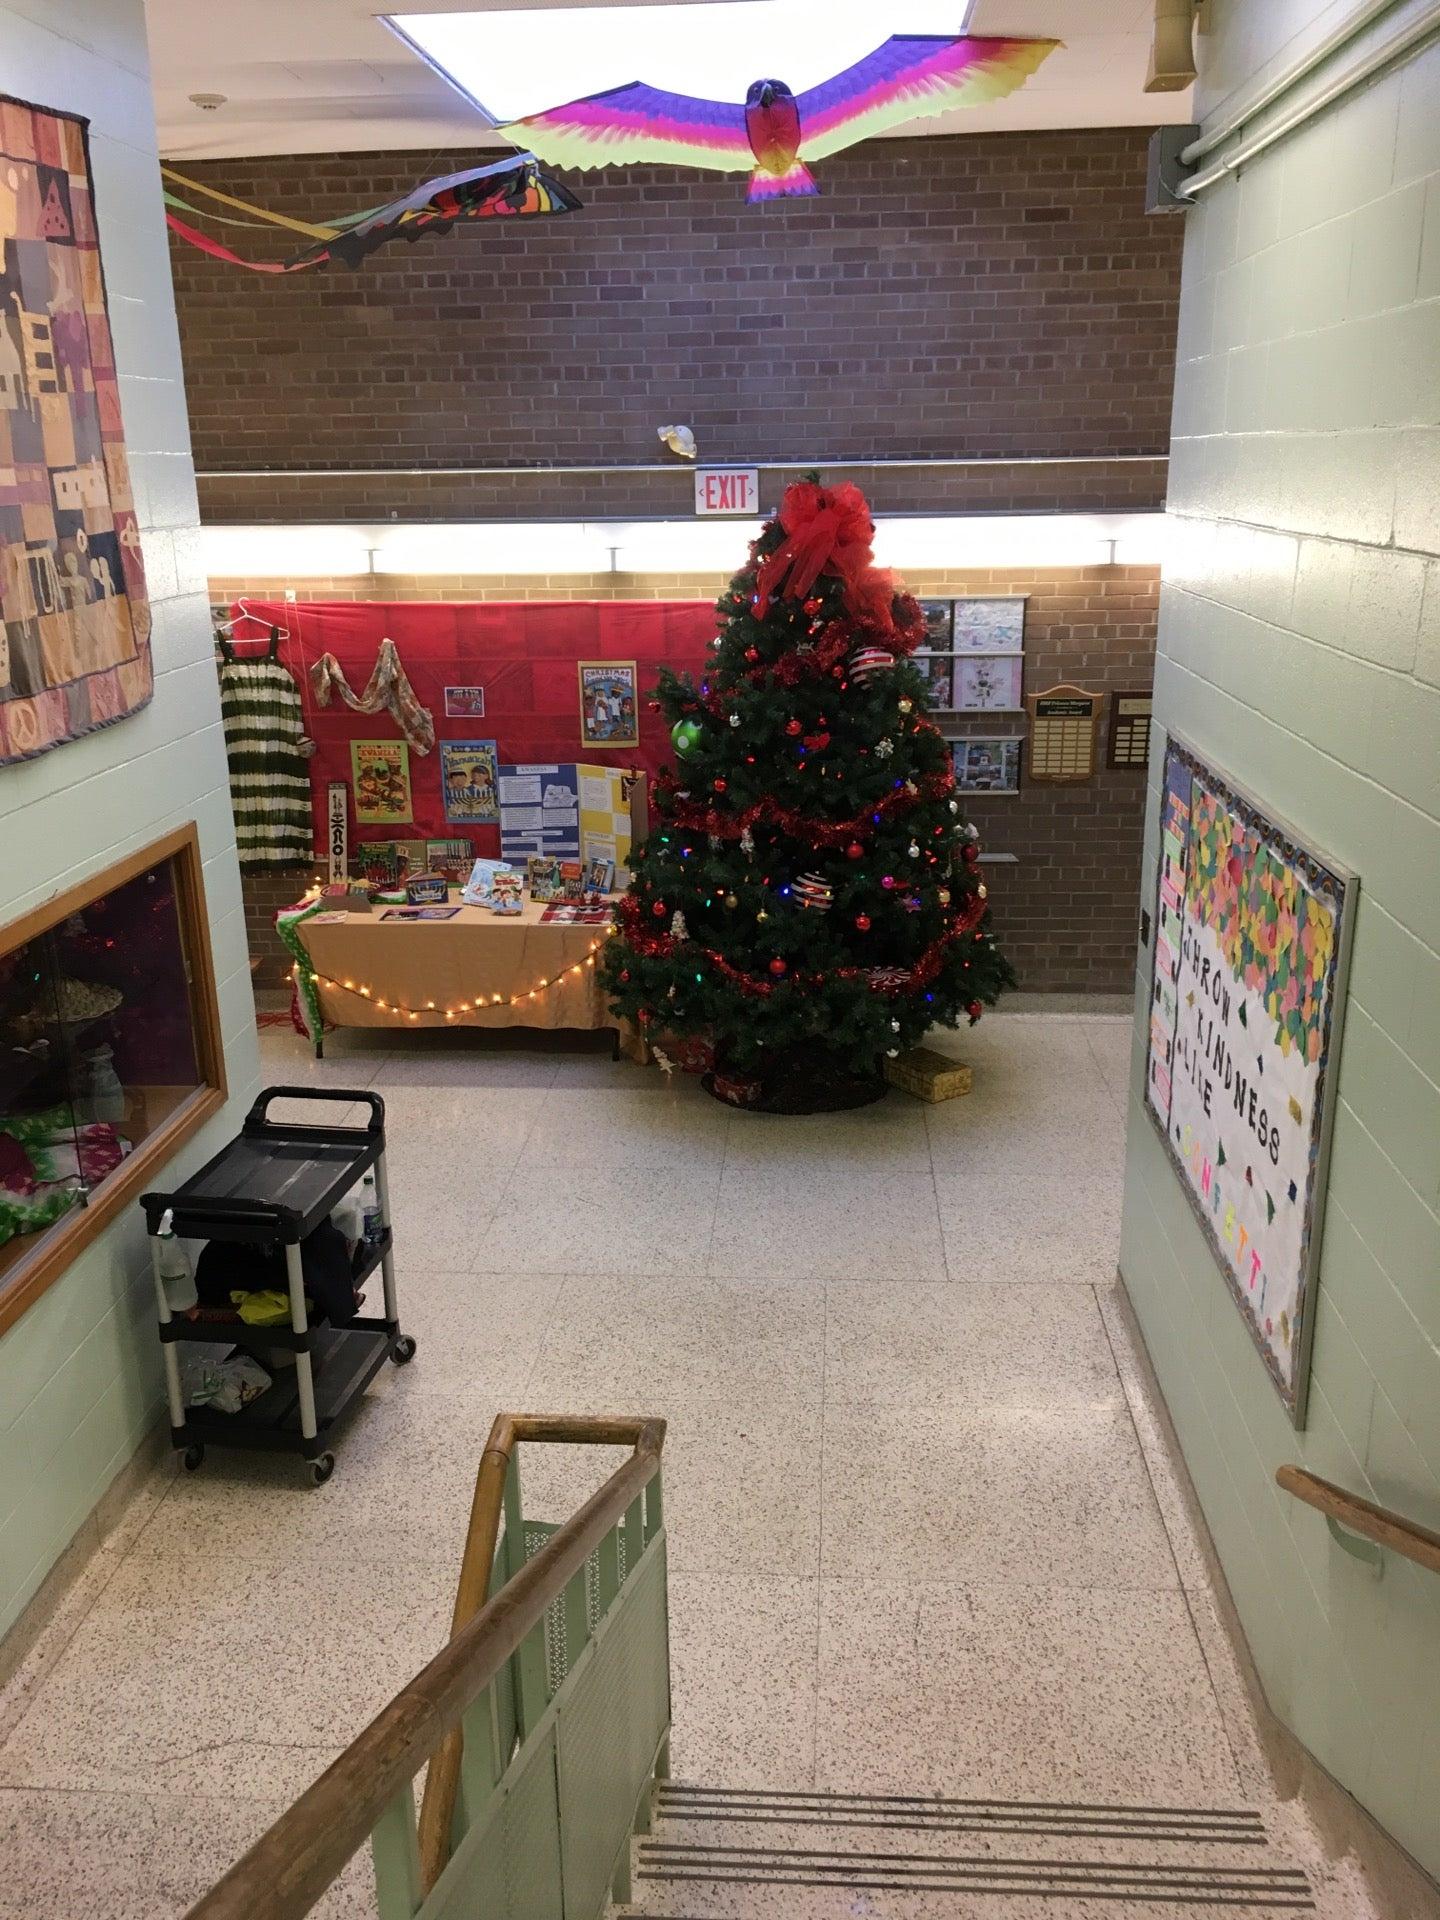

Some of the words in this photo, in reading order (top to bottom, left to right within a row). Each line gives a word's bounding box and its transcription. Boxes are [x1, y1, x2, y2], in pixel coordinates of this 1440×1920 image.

[705, 475, 749, 509] EXIT
[1183, 924, 1231, 1027] THROW
[1184, 1036, 1213, 1120] LIKE
[1197, 1007, 1281, 1166] KINDNESS
